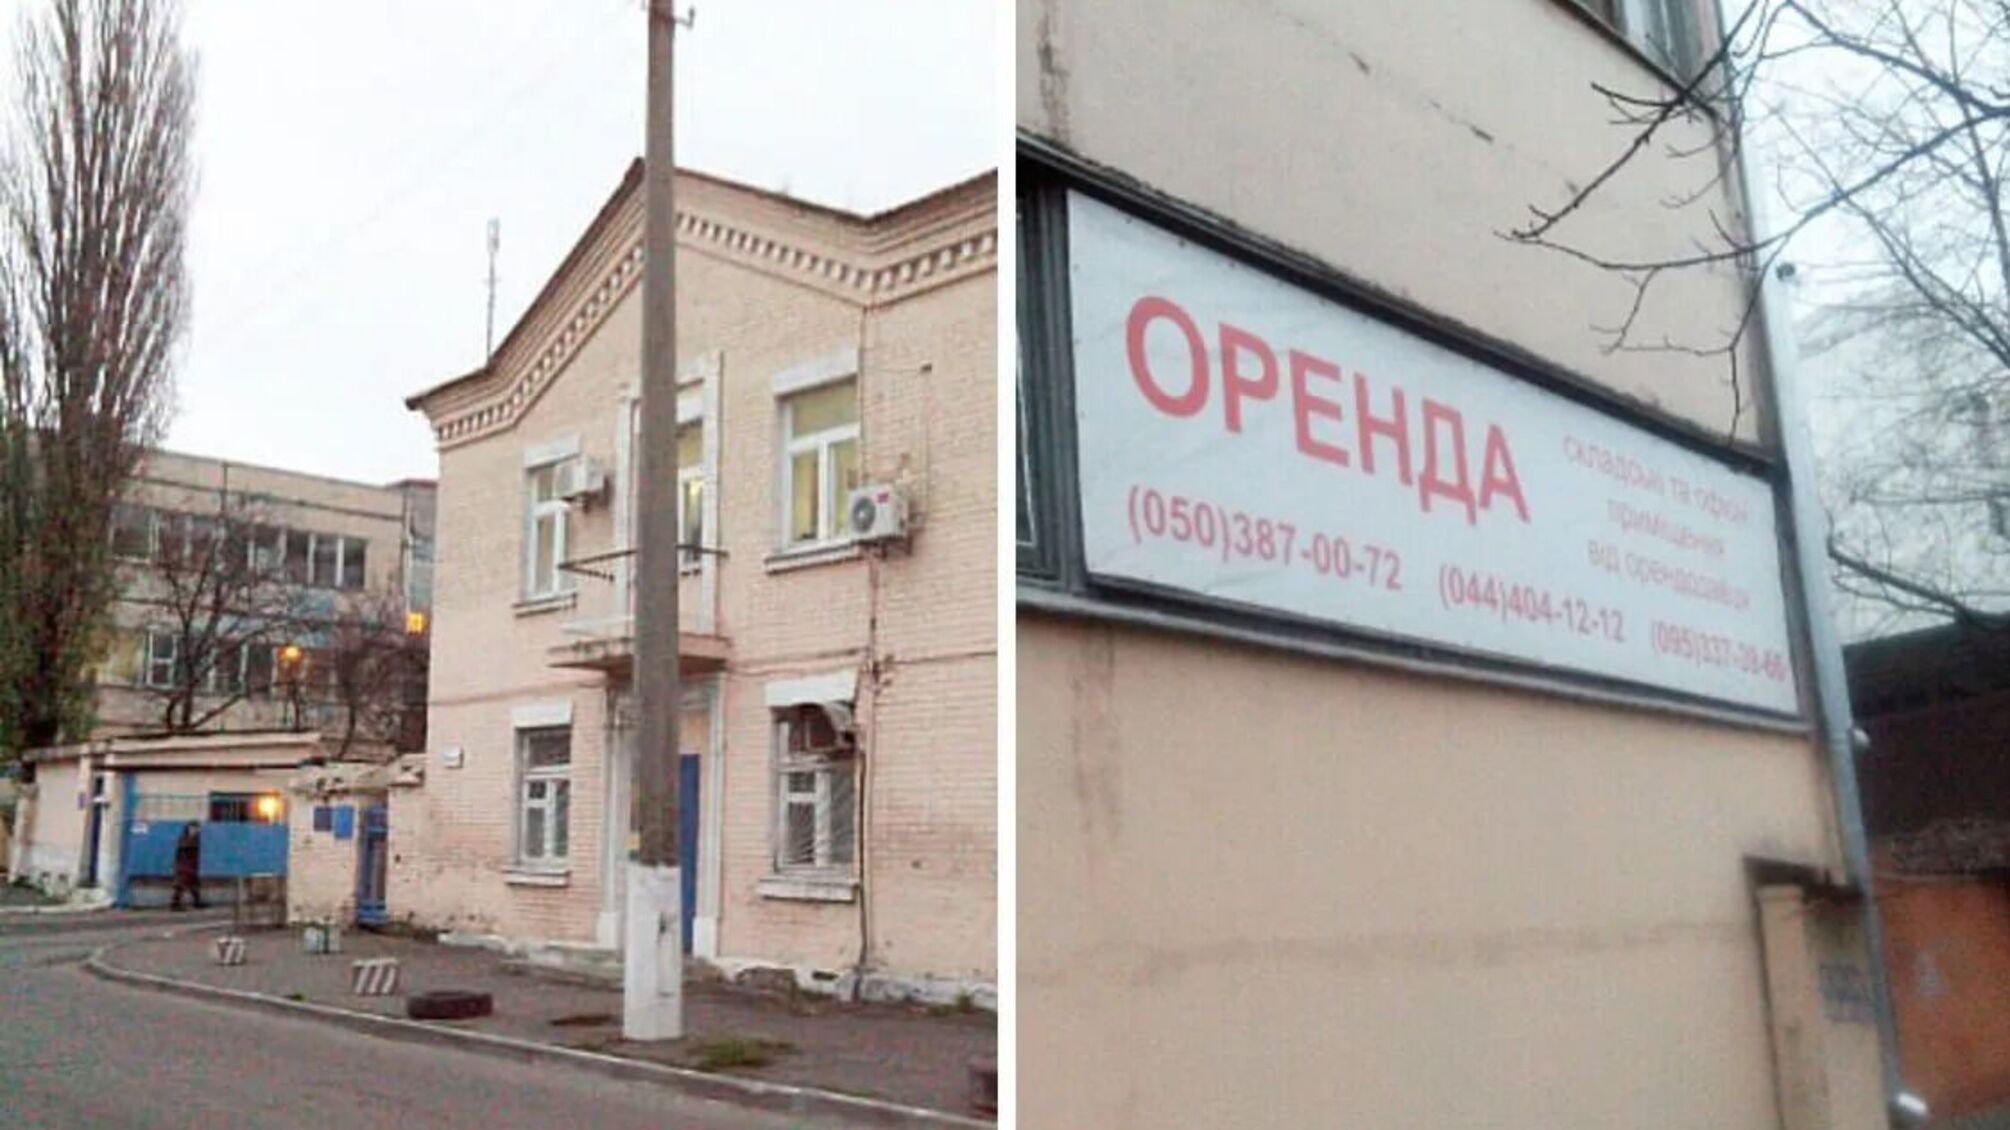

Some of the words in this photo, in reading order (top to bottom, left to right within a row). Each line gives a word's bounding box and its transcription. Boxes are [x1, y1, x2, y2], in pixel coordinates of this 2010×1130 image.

[1125, 296, 1531, 526] ОРЕНДА
[1128, 485, 1401, 591] (050)387-00-72
[1439, 562, 1627, 643] (044)404-12-12
